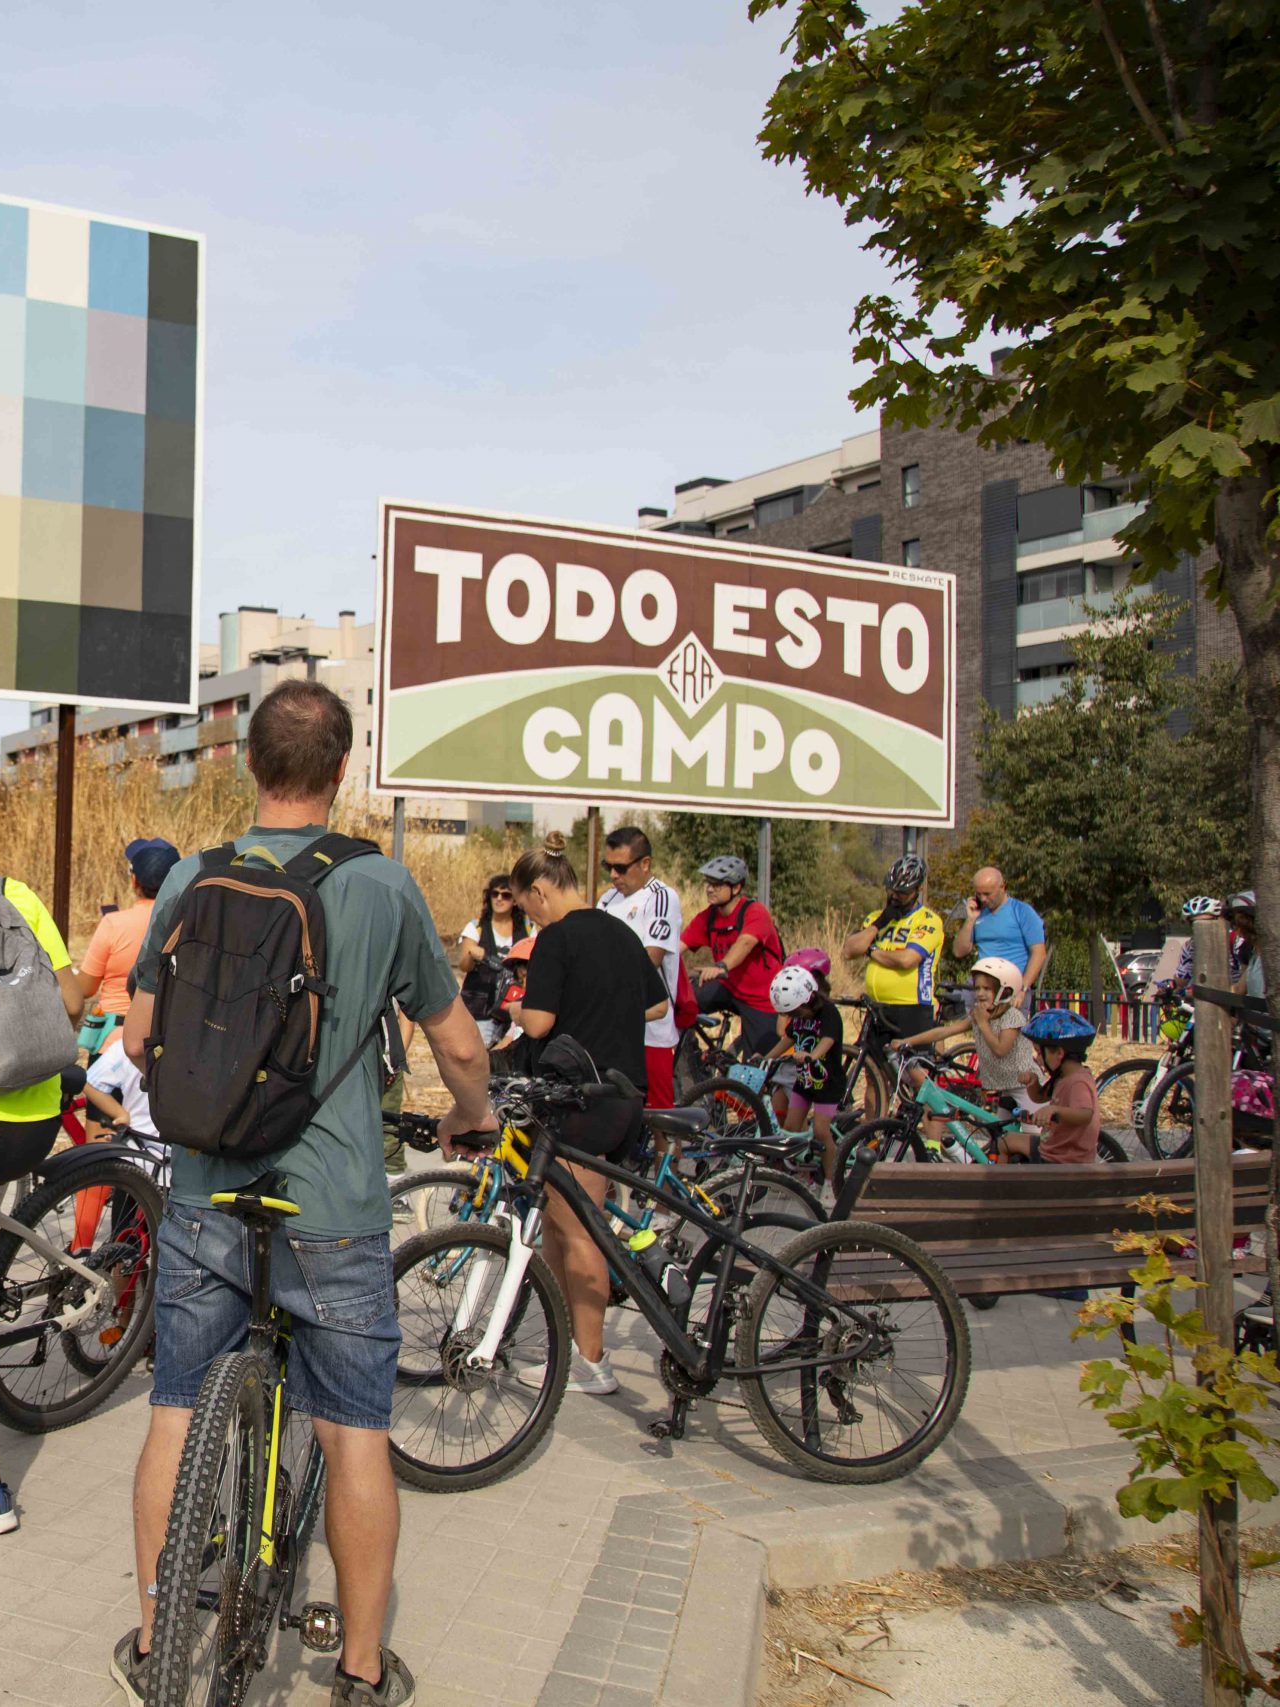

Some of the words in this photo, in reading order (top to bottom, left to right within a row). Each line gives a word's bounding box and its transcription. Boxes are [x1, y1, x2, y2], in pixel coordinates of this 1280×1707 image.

[892, 570, 945, 587] RESKATE
[414, 545, 677, 647] TODO
[713, 582, 930, 695] ESTO
[667, 641, 714, 704] ERA
[522, 692, 842, 796] CAMPO
[649, 919, 671, 941] hp
